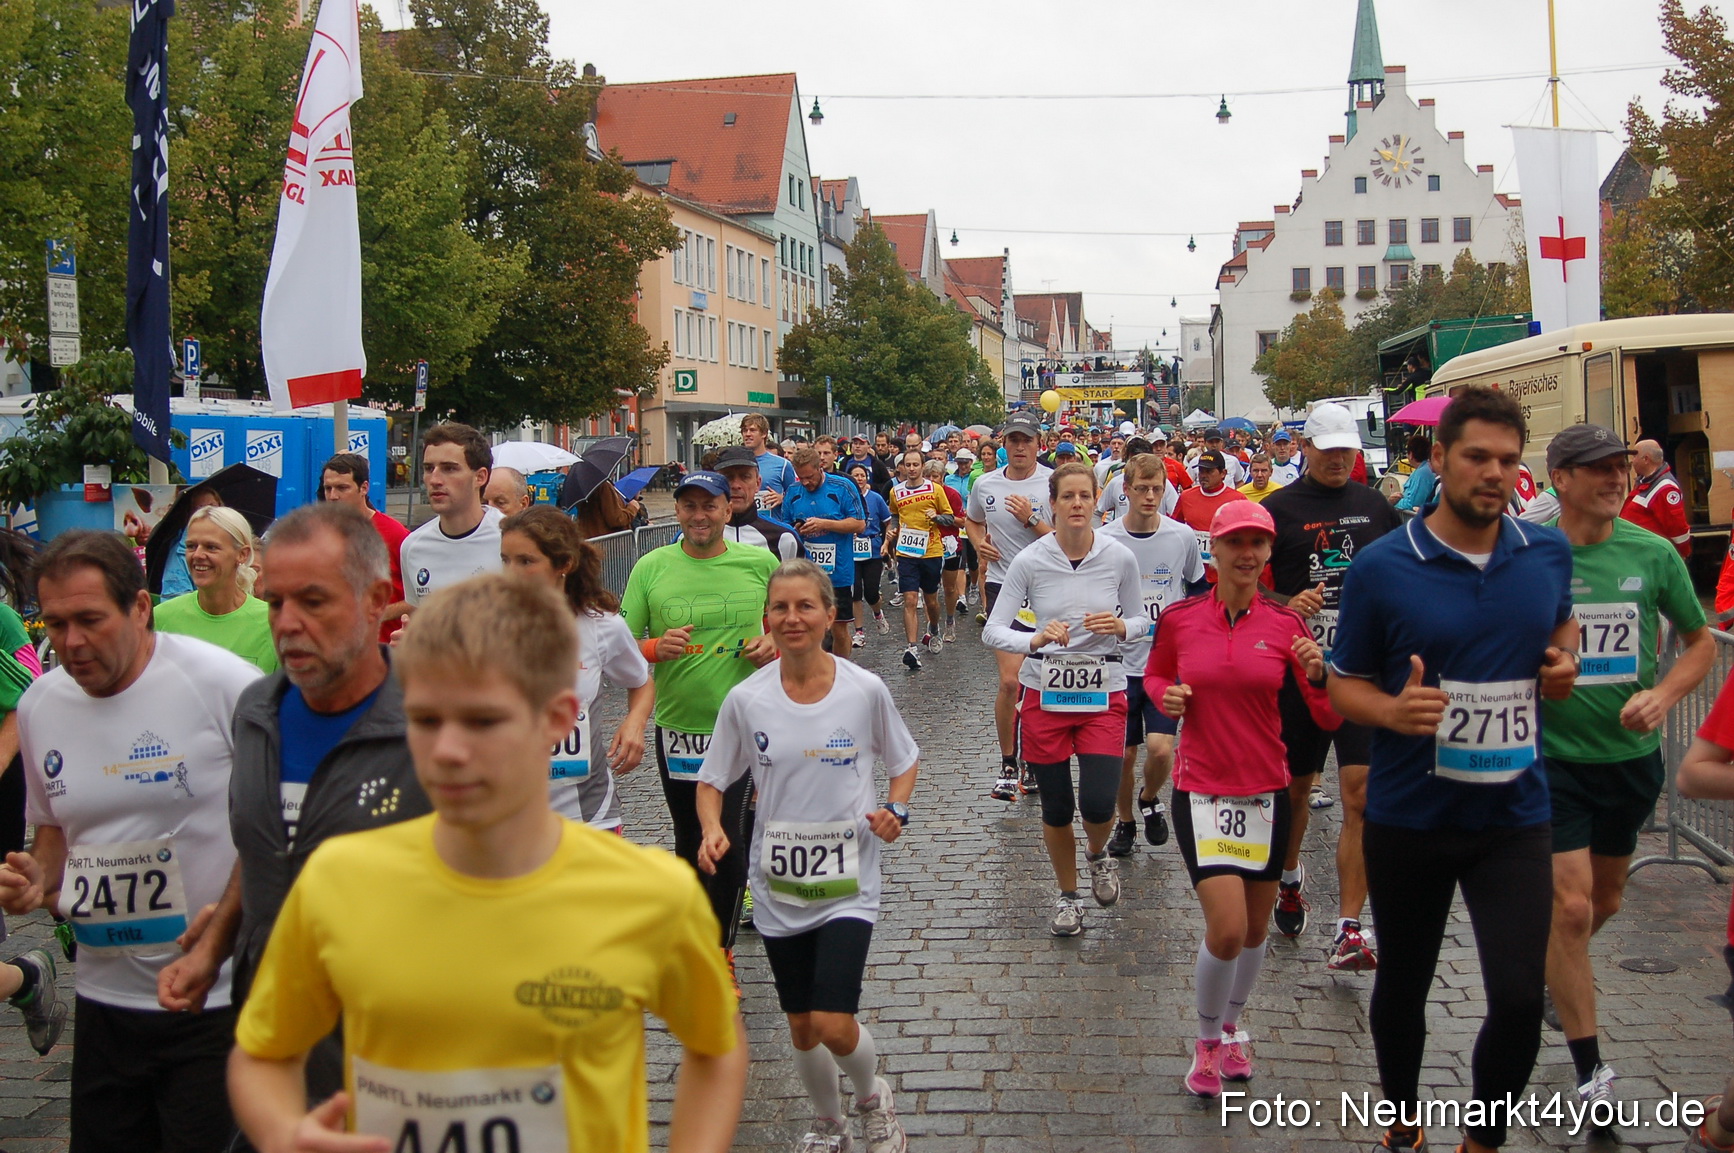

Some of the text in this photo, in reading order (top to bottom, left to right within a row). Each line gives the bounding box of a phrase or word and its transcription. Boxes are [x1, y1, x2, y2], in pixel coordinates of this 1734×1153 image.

[187, 344, 196, 366] P
[418, 366, 426, 383] P
[678, 373, 693, 389] D
[1083, 390, 1114, 398] START
[1509, 373, 1558, 400] Bayerisches
[898, 495, 935, 508] MAX BÖGL
[901, 535, 925, 547] 3044
[1309, 553, 1323, 570] 3.
[1579, 612, 1622, 620] Neumarkt
[1044, 658, 1065, 666] PARTL
[1048, 668, 1103, 689] 2034
[1056, 694, 1092, 704] Carolina
[1480, 691, 1522, 703] Neumarkt
[1448, 706, 1529, 744] 2715
[1469, 754, 1512, 768] Stefan
[1219, 809, 1246, 838] 38
[765, 831, 840, 841] PARTL Neumarkt
[68, 854, 152, 869] PARTL Neumarkt
[770, 843, 845, 878] 5021
[71, 869, 172, 918] 2472
[107, 926, 143, 943] Fritz
[358, 1076, 522, 1109] PARTL Neumarkt
